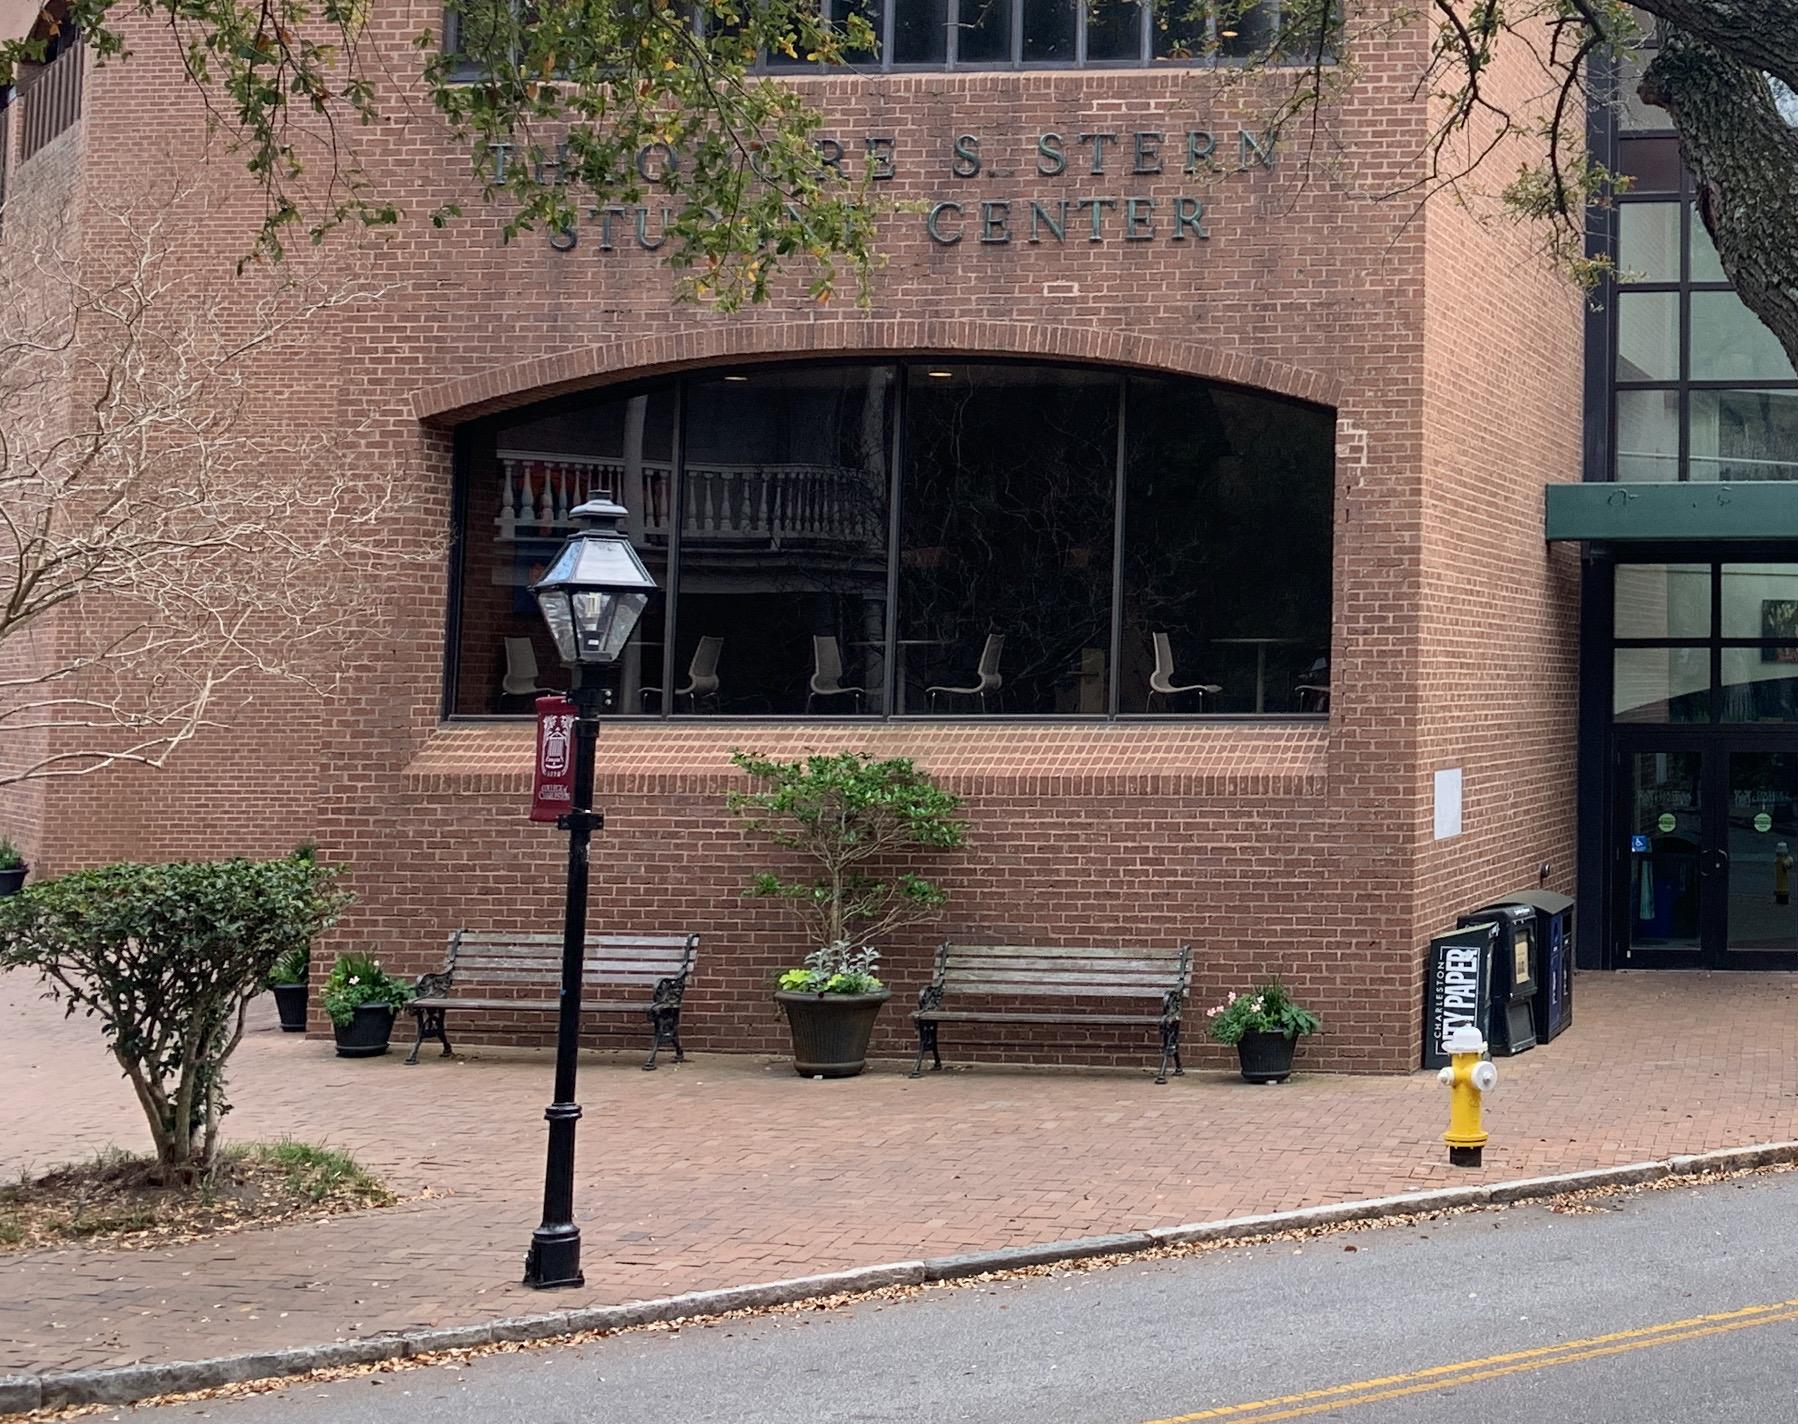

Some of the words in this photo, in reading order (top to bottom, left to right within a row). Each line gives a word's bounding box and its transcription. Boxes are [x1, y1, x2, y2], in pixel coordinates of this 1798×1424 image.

[952, 133, 996, 178] S.
[1036, 130, 1276, 176] STERN
[926, 196, 1209, 244] CENTER
[1434, 961, 1445, 1039] CHARLESTON
[1443, 948, 1478, 1009] PAPER
